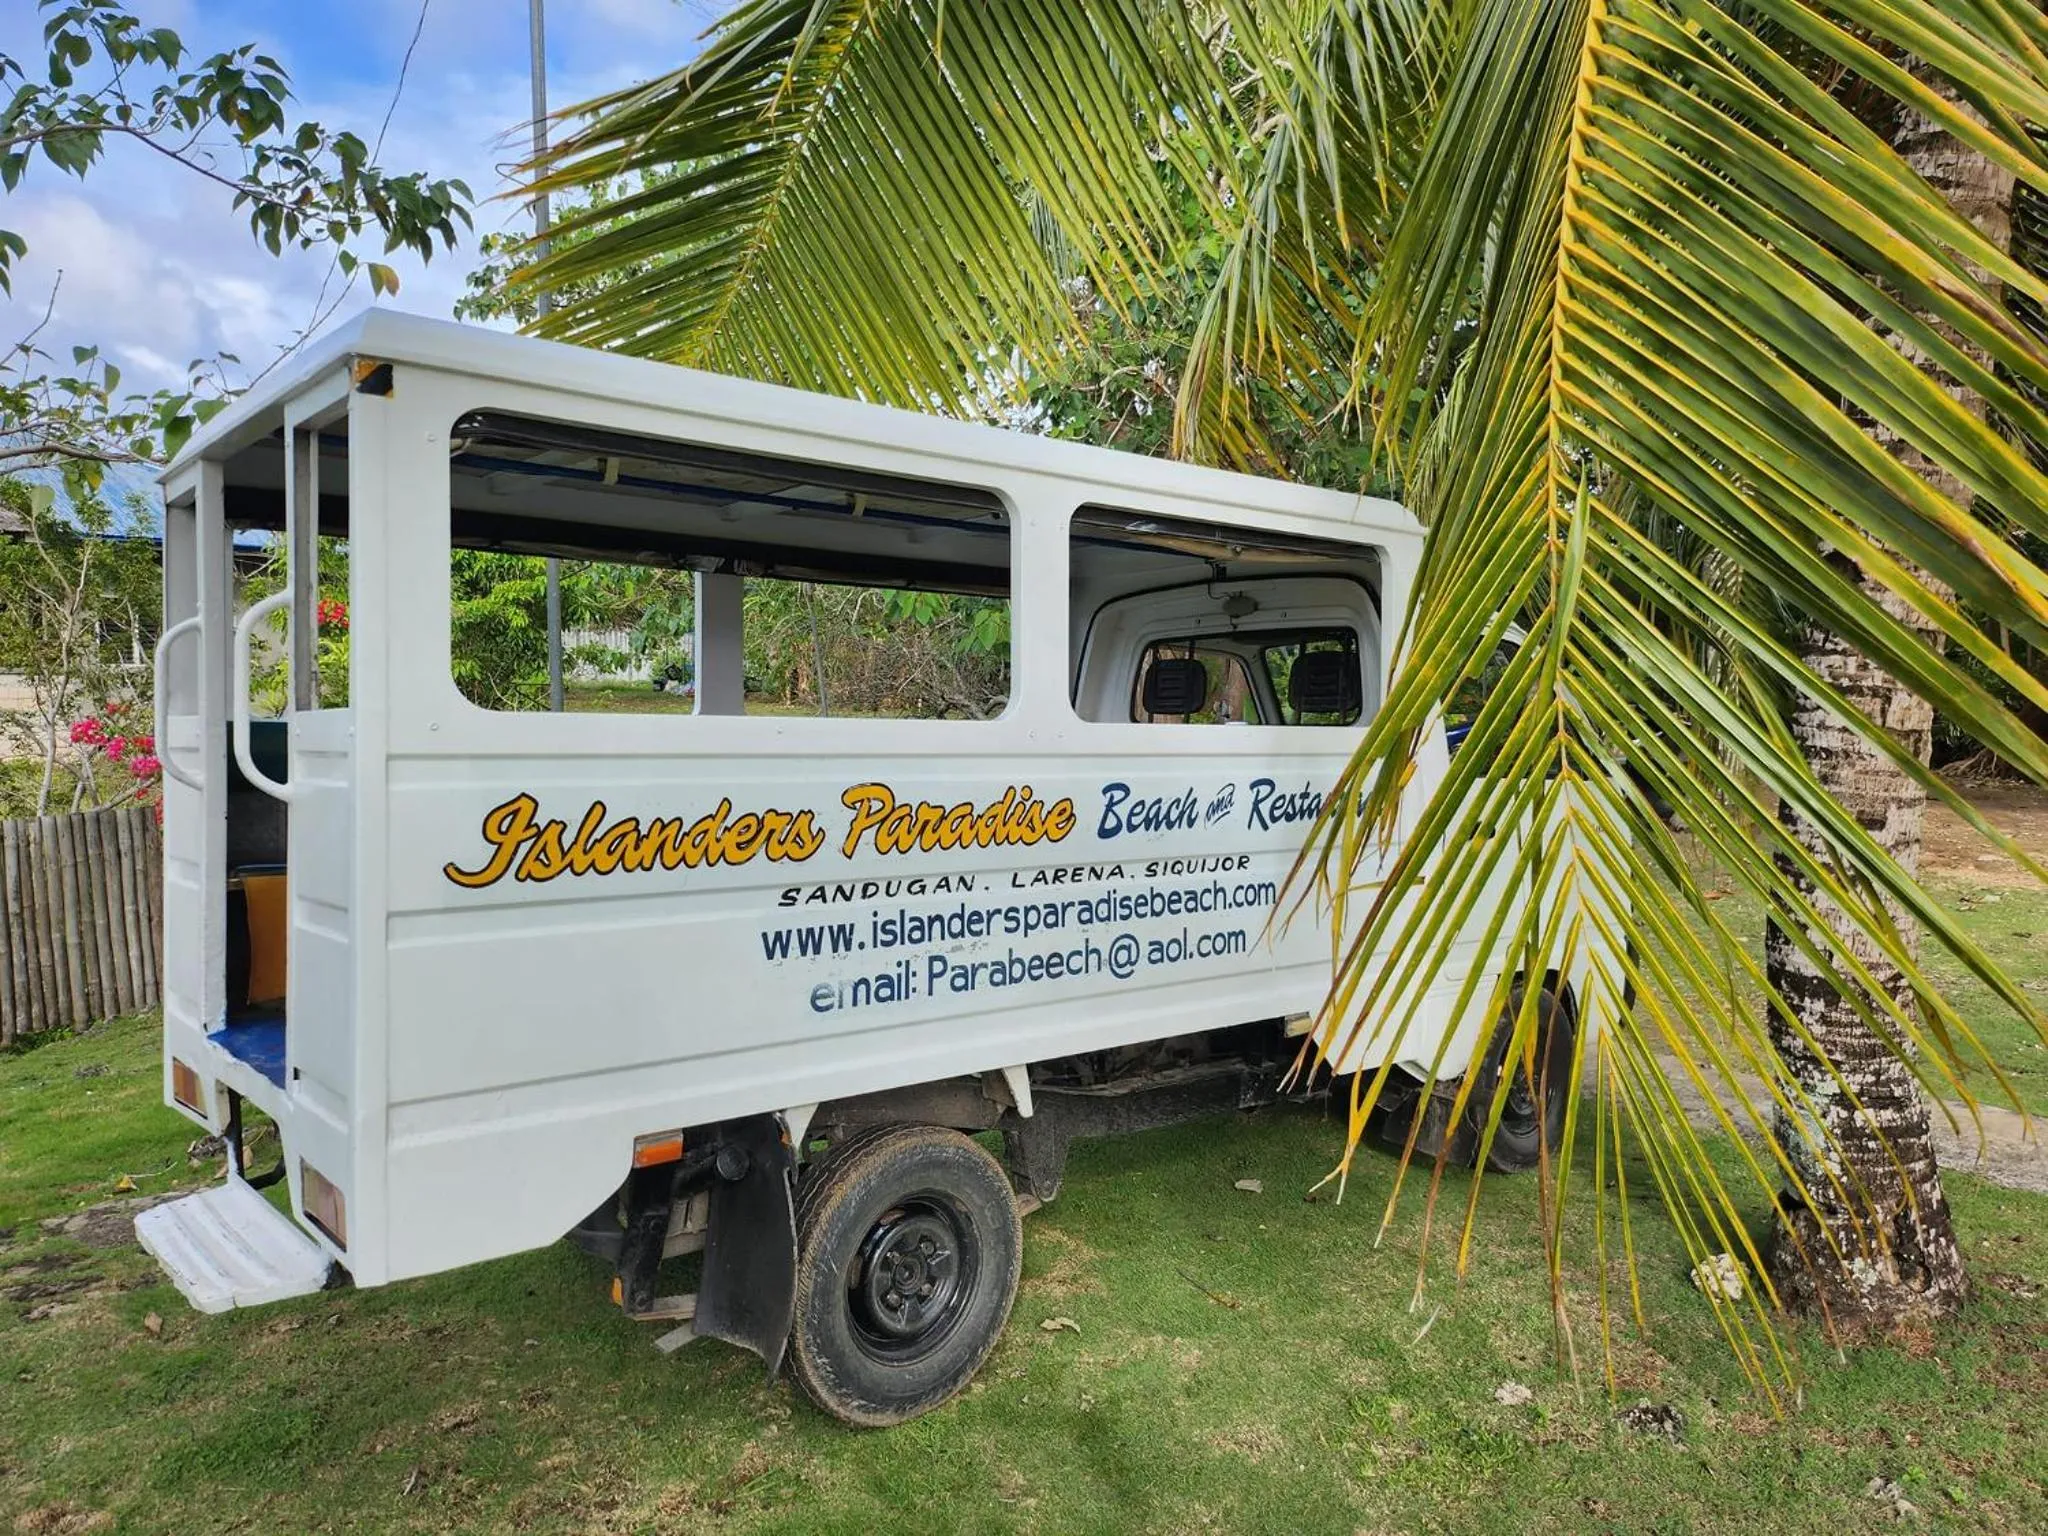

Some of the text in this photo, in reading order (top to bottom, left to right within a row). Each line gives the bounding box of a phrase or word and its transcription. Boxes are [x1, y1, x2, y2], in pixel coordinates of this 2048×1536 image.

[443, 792, 825, 889] Islanders
[841, 782, 1077, 859] Paradise
[1097, 782, 1200, 840] Beach
[1144, 855, 1251, 878] SIQUIJOR
[760, 878, 1277, 962] www.islandersparadisebeach.com
